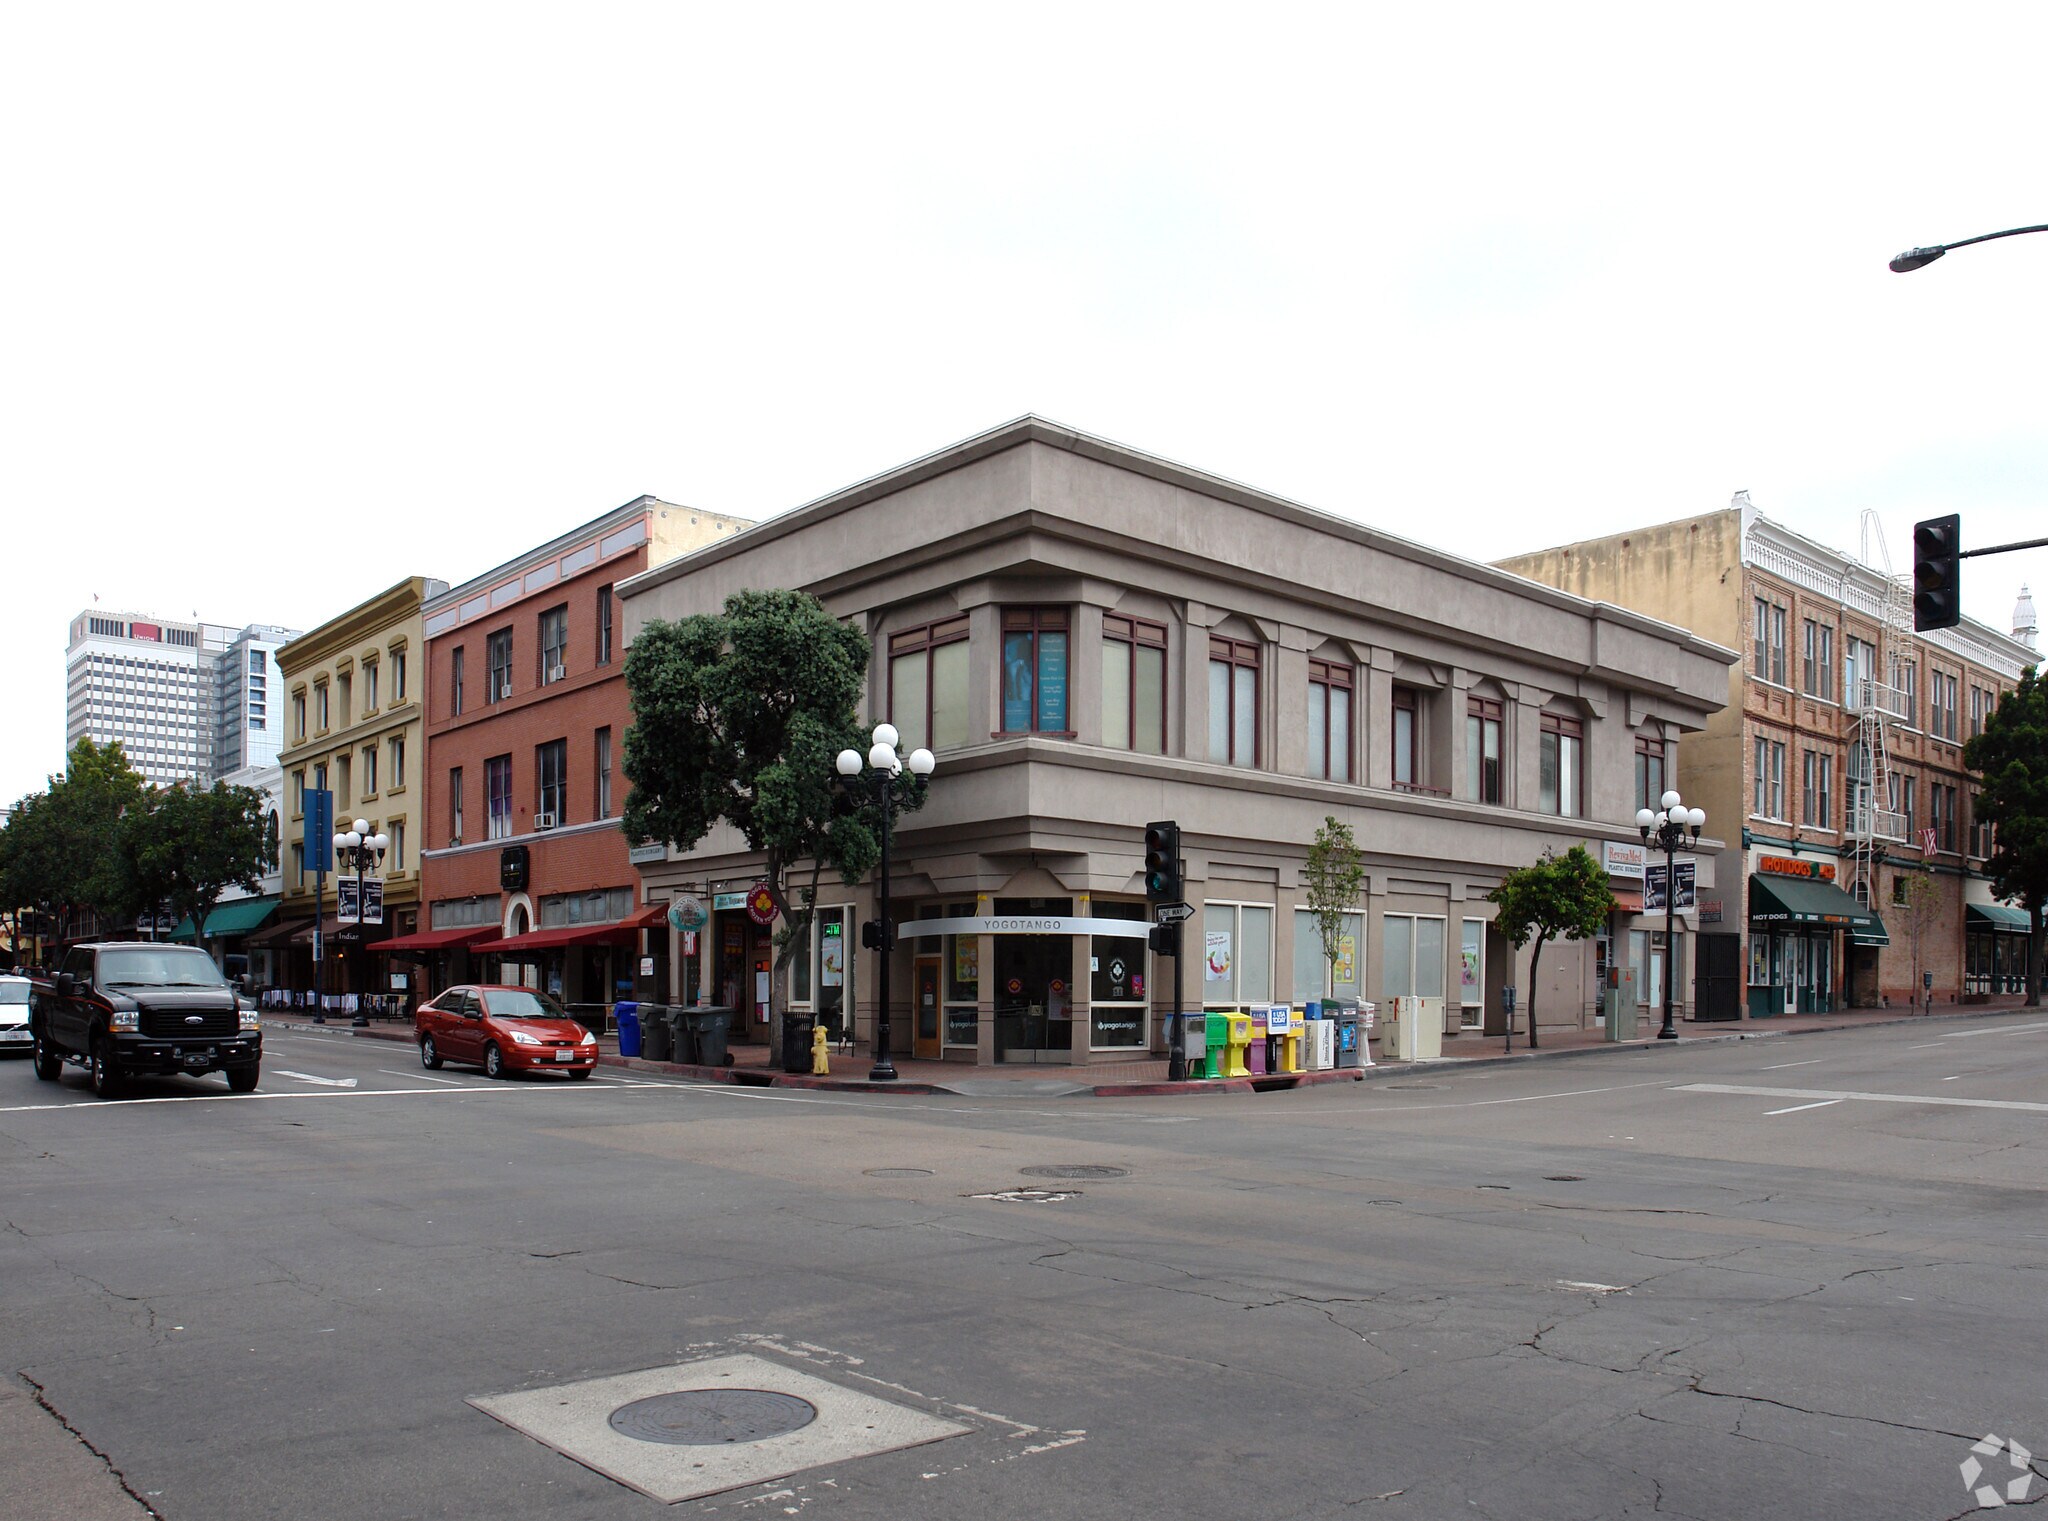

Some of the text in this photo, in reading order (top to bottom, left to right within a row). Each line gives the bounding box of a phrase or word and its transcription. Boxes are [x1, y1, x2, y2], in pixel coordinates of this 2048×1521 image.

[1608, 864, 1642, 874] PLASTIC SURGERY
[1763, 856, 1785, 872] HOT
[1787, 859, 1811, 877] DOGS
[1171, 908, 1183, 916] WAY
[825, 925, 840, 935] ATM
[984, 920, 1061, 930] YOGOTANGO
[1103, 1022, 1136, 1031] yogotango
